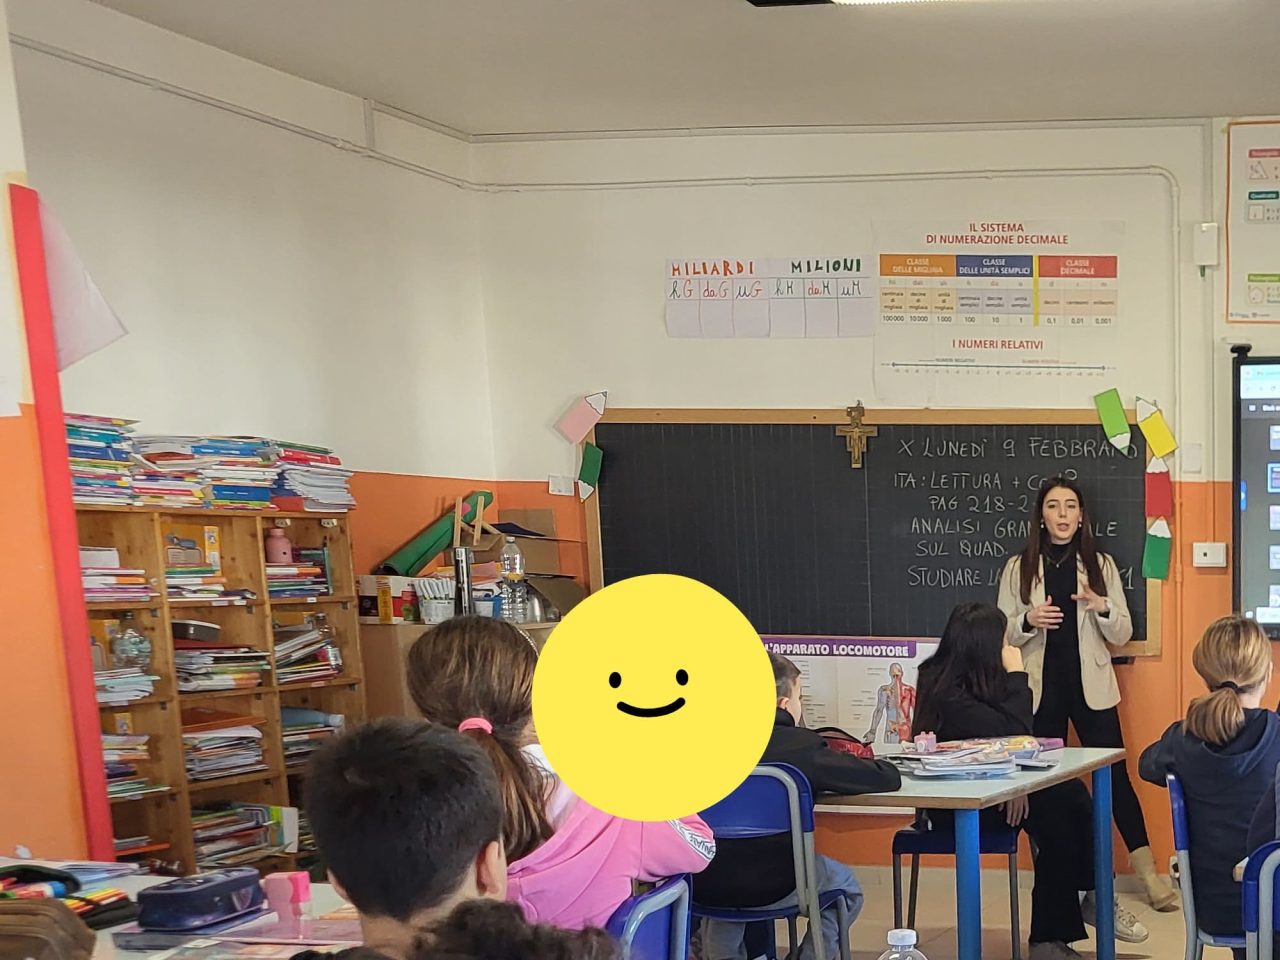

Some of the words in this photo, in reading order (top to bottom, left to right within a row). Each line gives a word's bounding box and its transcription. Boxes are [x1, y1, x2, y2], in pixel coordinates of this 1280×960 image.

[969, 223, 978, 232] IL
[981, 223, 1024, 232] SISTEMA
[926, 235, 937, 244] DI
[940, 235, 1014, 244] NUMERAZIONE
[1017, 235, 1068, 244] DECIMALE
[671, 260, 754, 276] MILIARDI
[791, 258, 861, 274] MILIONI
[958, 339, 998, 349] NUMERI
[1000, 340, 1044, 350] RELATIVI
[897, 439, 915, 457] X
[1002, 439, 1015, 457] 9
[930, 471, 1001, 491] LETTURA
[928, 495, 958, 511] PAG
[969, 495, 1036, 513] 218-2
[911, 517, 981, 535] ANALISI
[915, 540, 949, 557] SUL
[907, 565, 982, 589] STUDIARE
[833, 645, 909, 657] LOCOMOTORE
